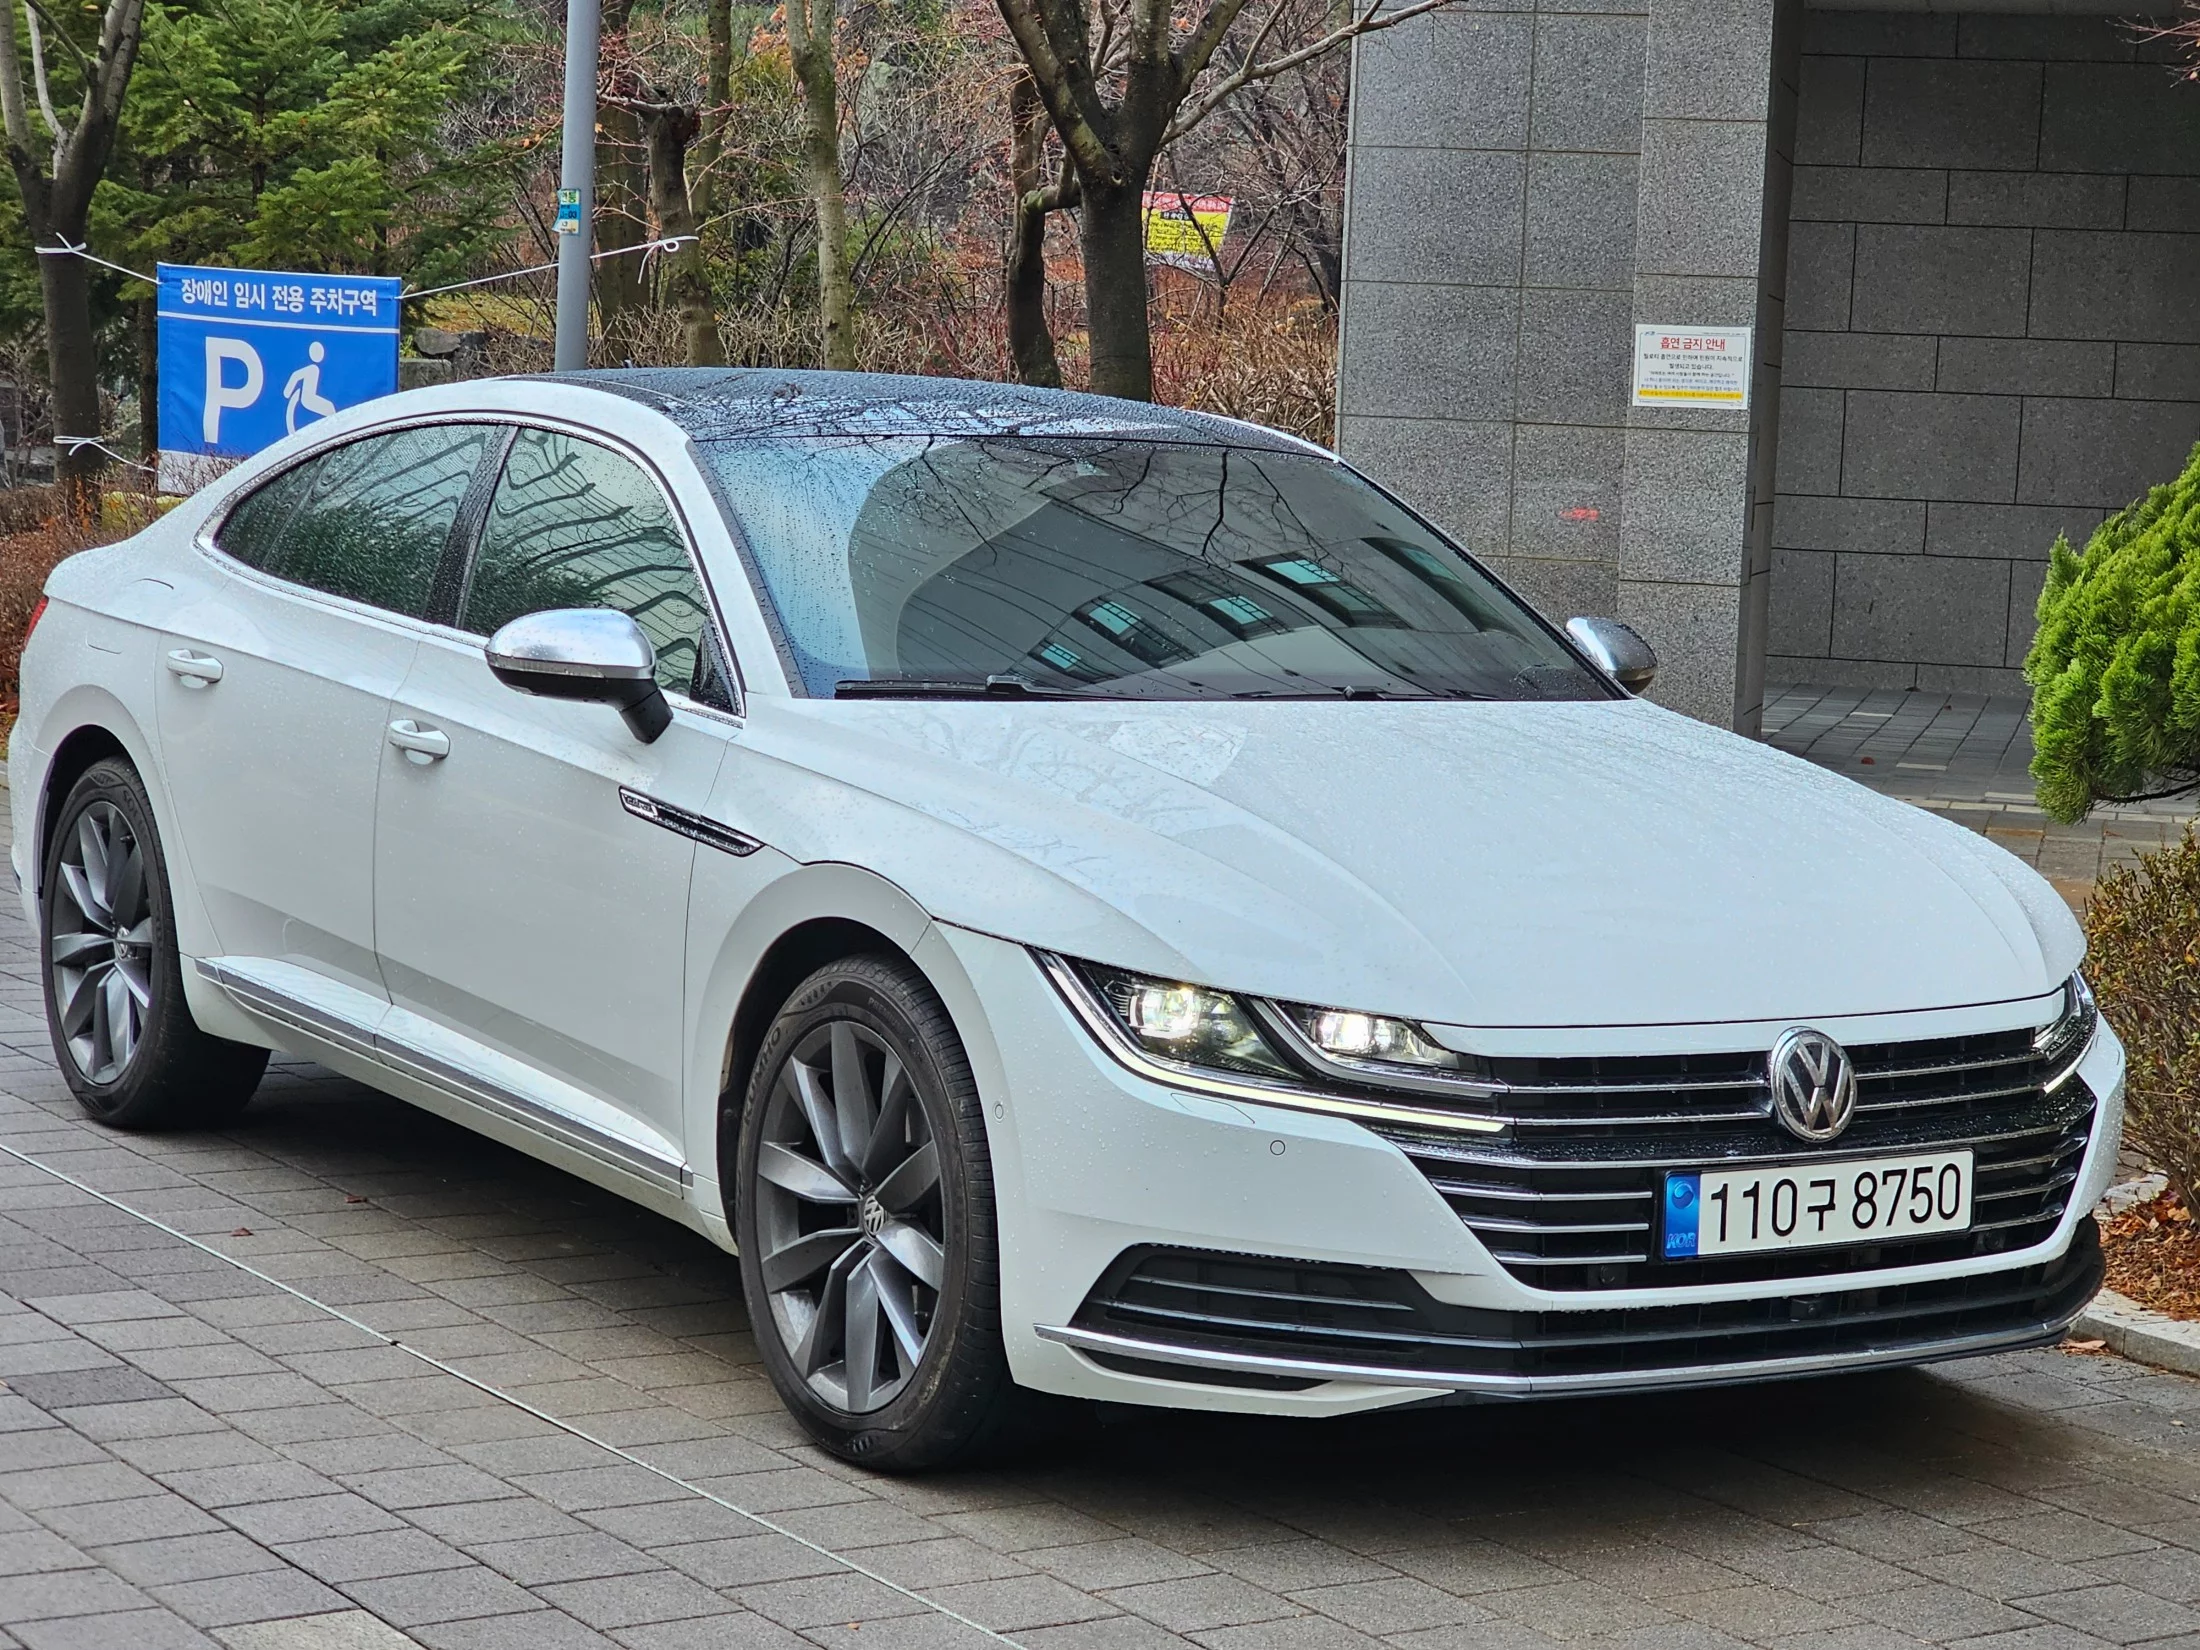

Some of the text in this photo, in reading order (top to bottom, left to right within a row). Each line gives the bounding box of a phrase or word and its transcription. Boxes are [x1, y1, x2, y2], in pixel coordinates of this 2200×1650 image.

[181, 278, 377, 317] 장애인 임시 전용 주차구역
[1660, 336, 1725, 351] 흡연 금지 안내
[202, 336, 264, 445] P
[743, 1026, 781, 1126] KUMHO
[1710, 1162, 1961, 1243] 110구 8750
[1666, 1232, 1696, 1249] KOR
